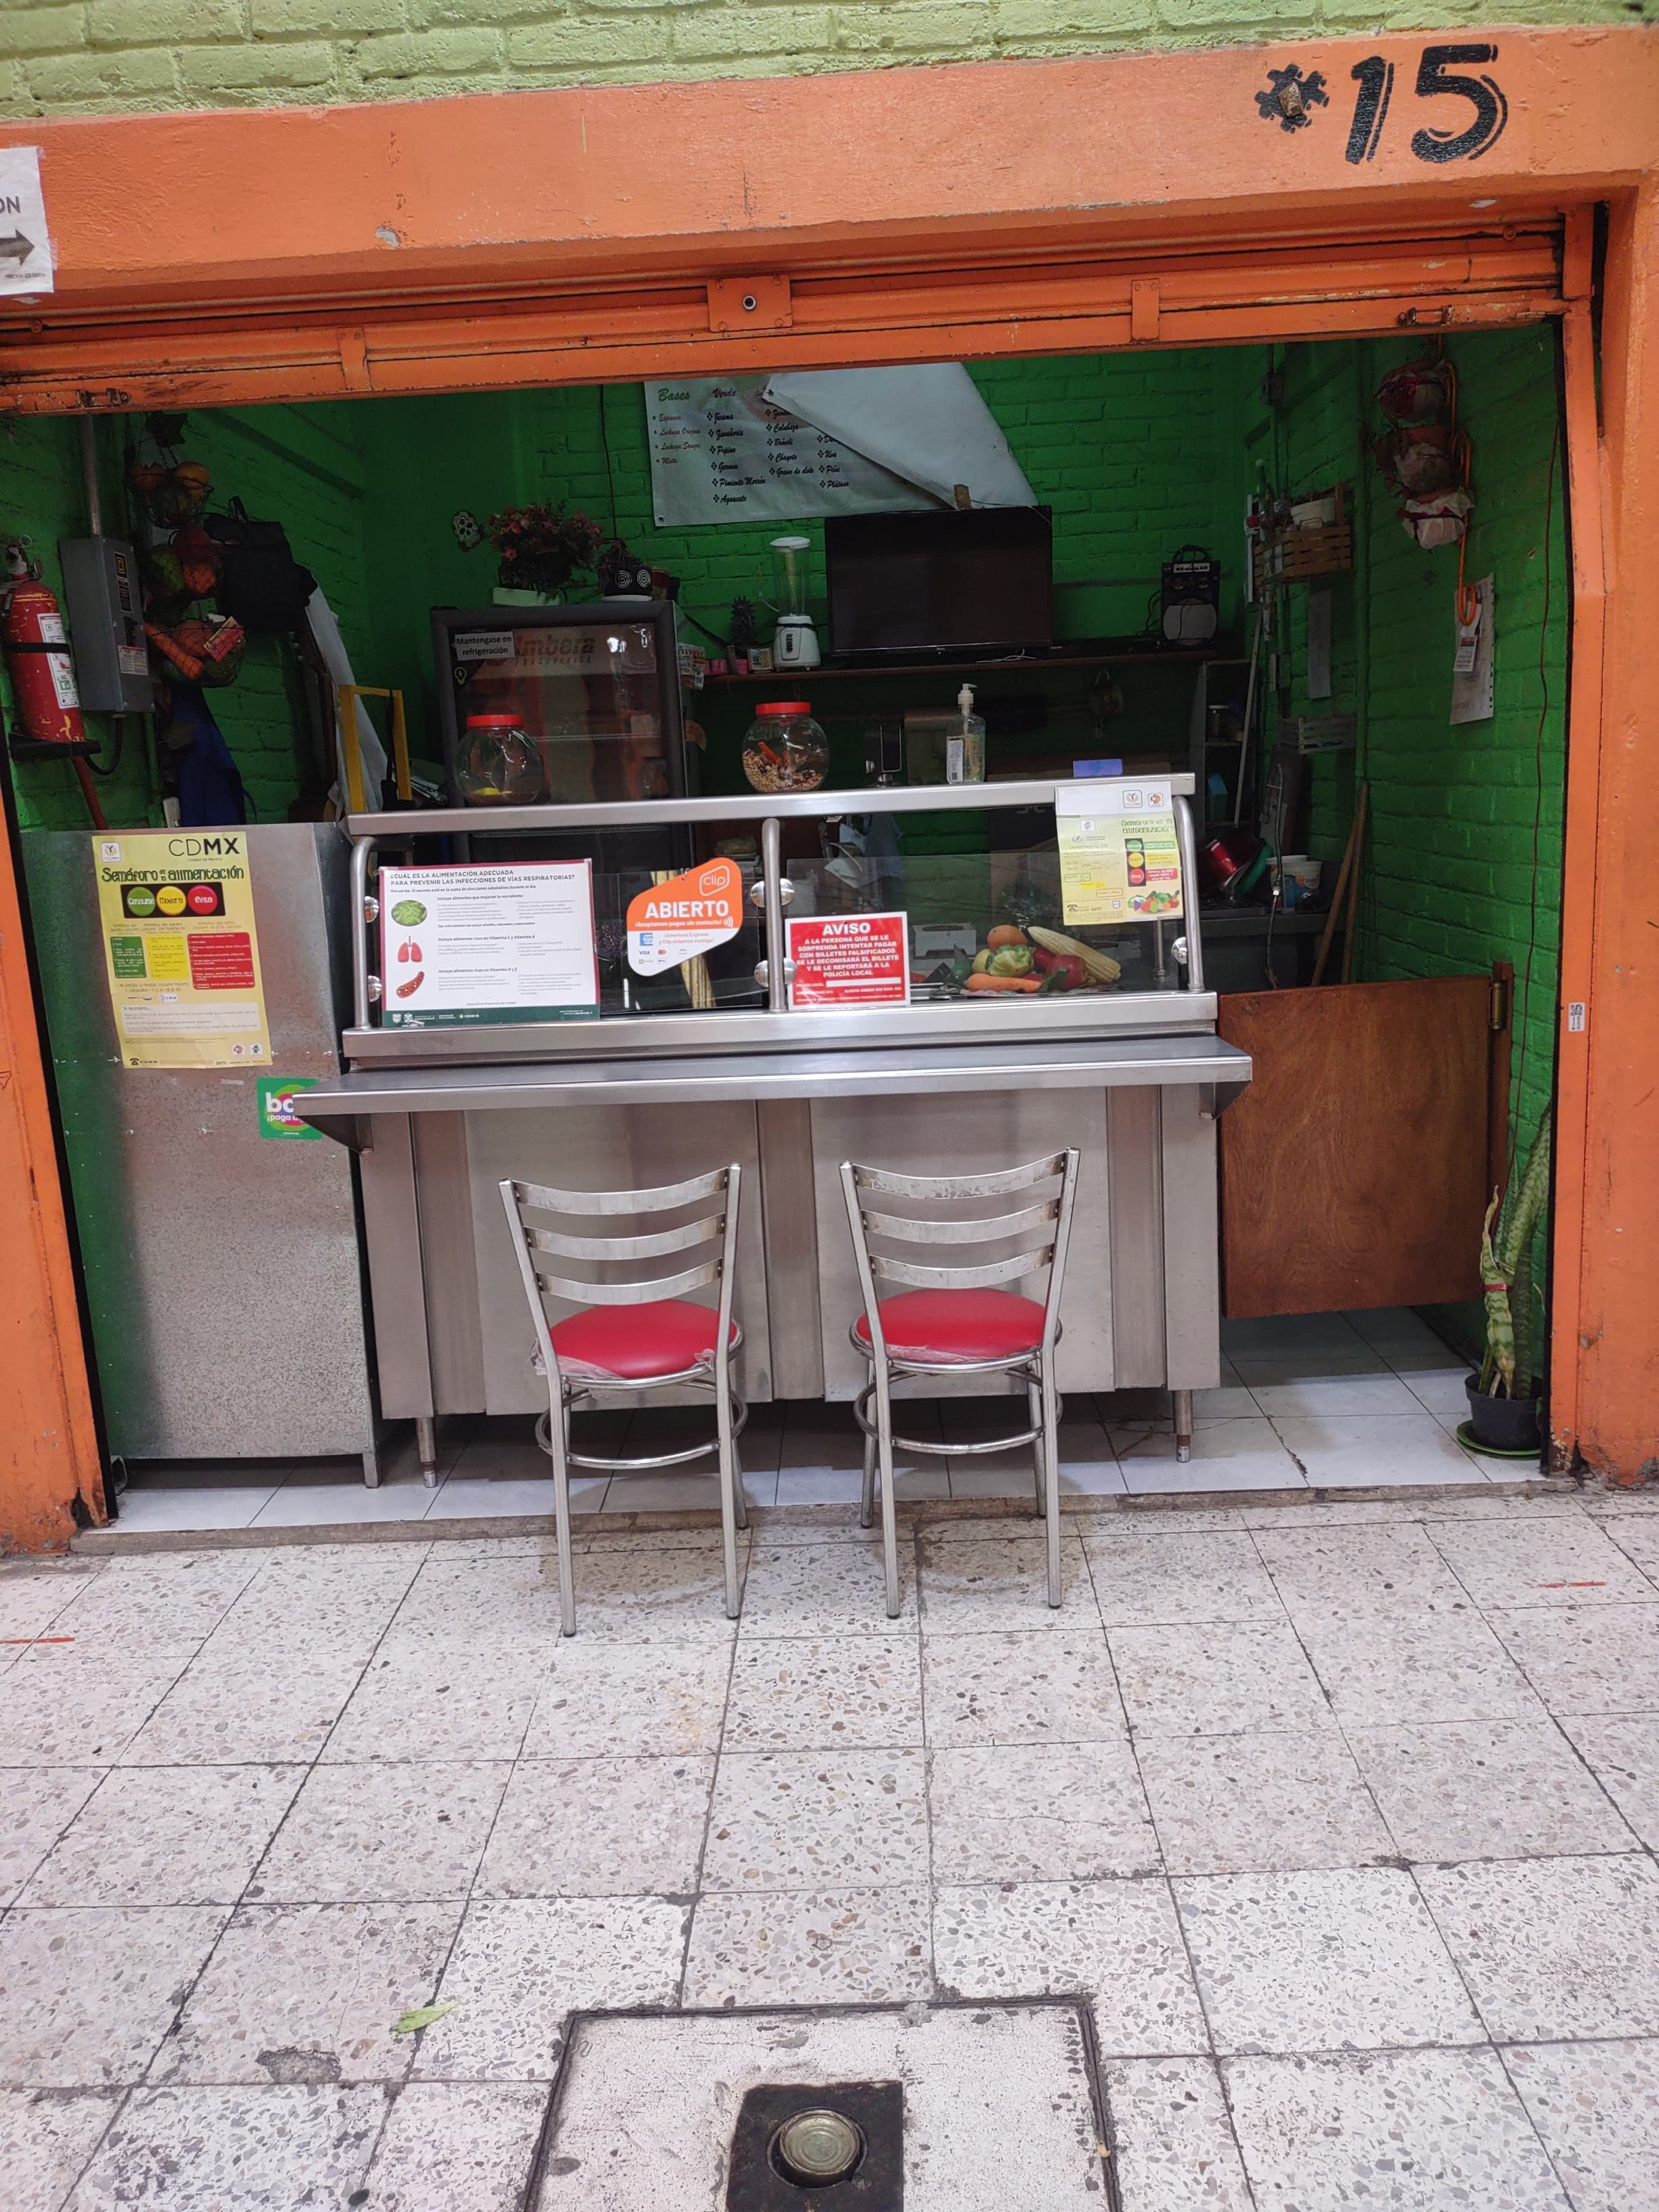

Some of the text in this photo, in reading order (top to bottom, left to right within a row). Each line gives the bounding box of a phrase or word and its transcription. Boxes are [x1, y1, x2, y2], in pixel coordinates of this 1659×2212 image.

[658, 388, 690, 402] Bases
[713, 388, 736, 398] Verde
[774, 423, 798, 433] Calabaza
[717, 445, 736, 456] Pepino
[825, 450, 837, 458] Uva
[775, 453, 797, 462] Chayote
[718, 462, 738, 473] Germen
[776, 468, 792, 477] Grano
[826, 465, 840, 474] Piña
[720, 494, 747, 505] Aguacate
[456, 636, 501, 647] Mantengase
[462, 647, 508, 657] refrigeración
[169, 838, 240, 856] CDMX
[102, 867, 157, 882] Semáforo
[168, 865, 244, 881] alimentación
[645, 900, 729, 919] ABIERTO
[822, 922, 871, 935] AVISO
[817, 956, 860, 964] DECOMISARÁ
[833, 962, 873, 970] REPORTARÁ
